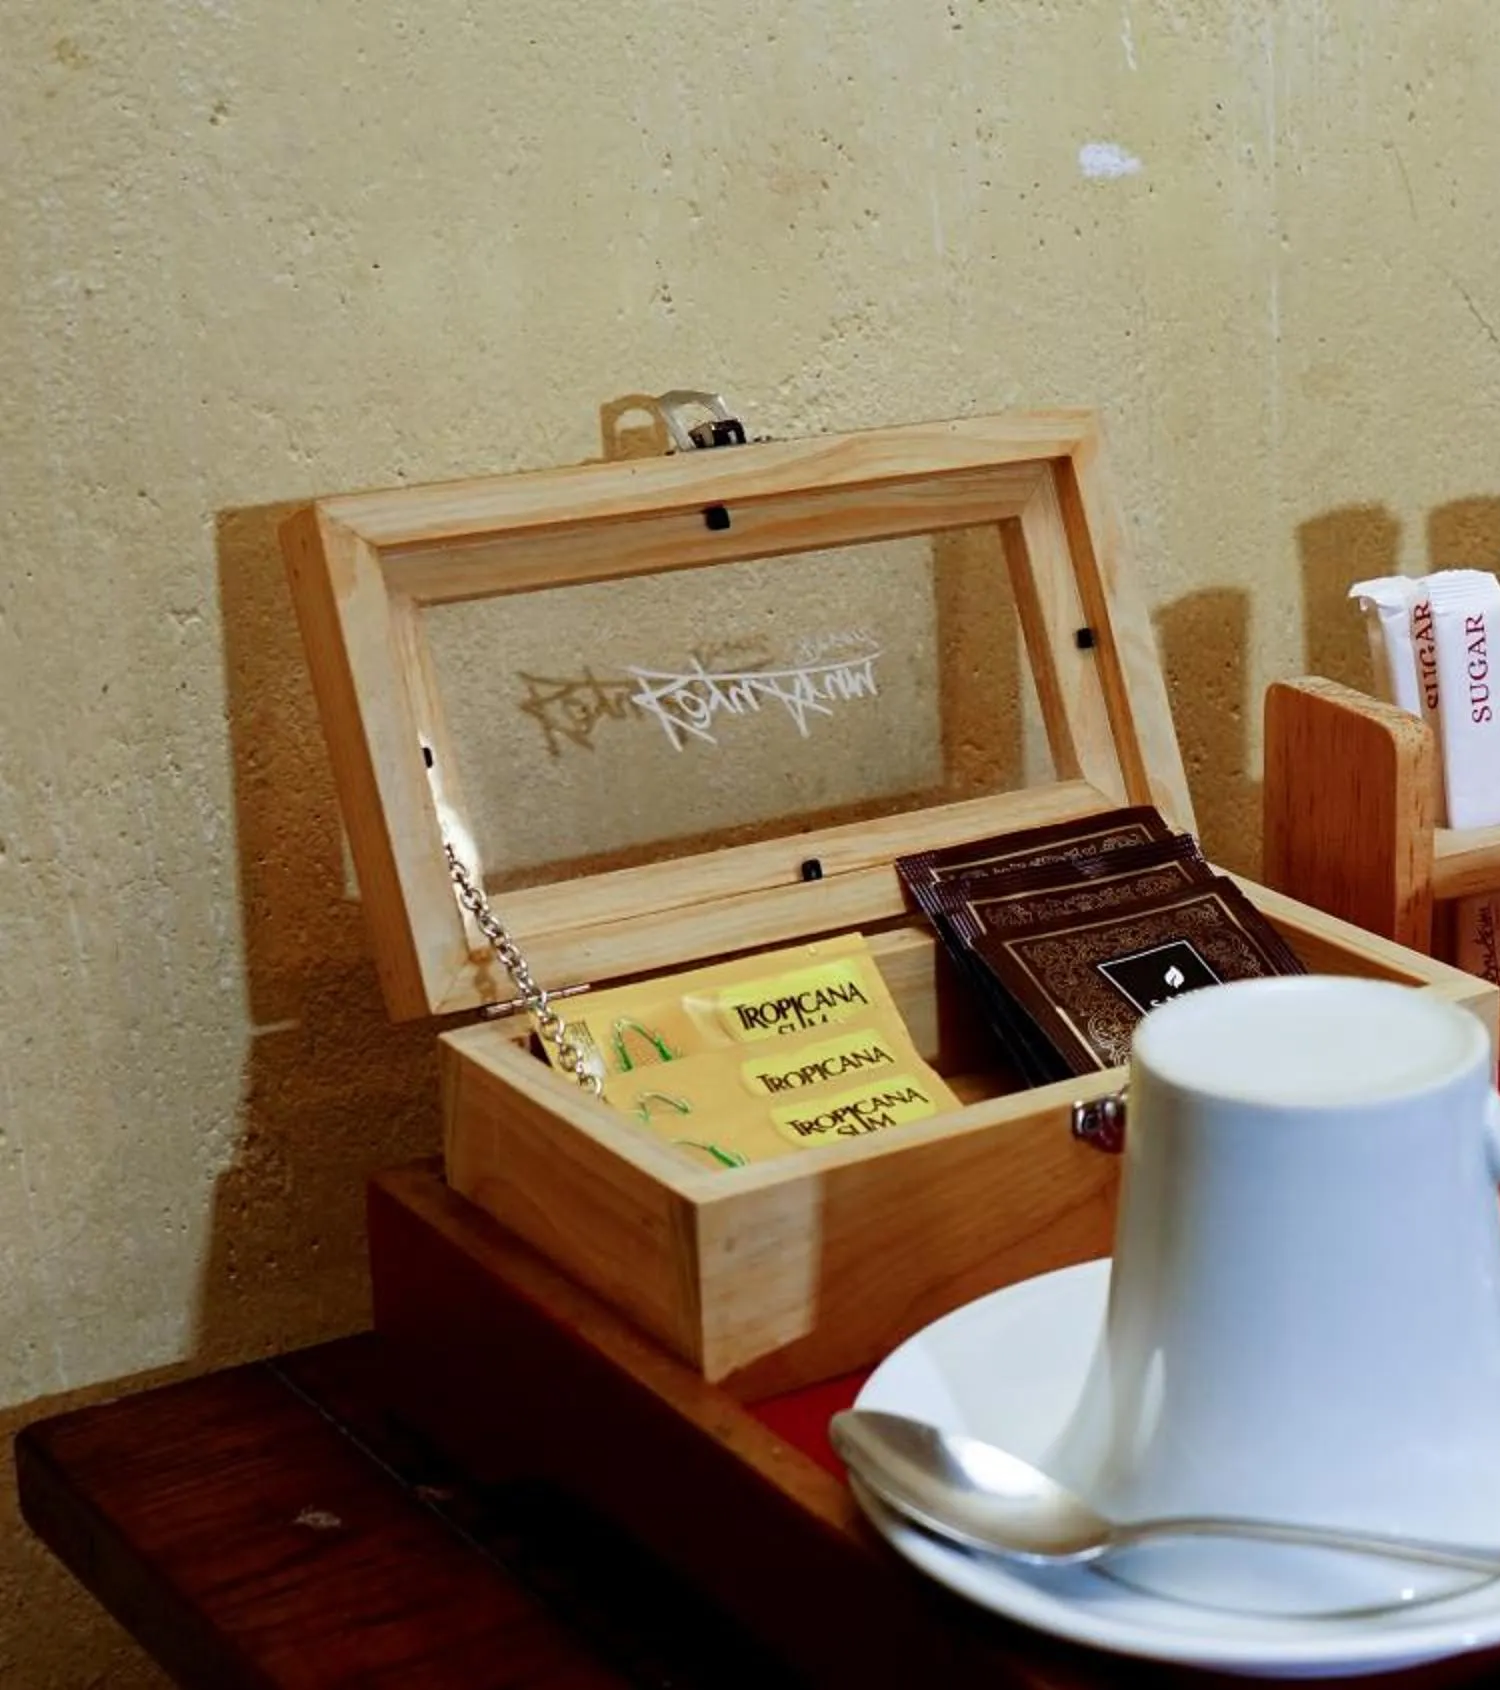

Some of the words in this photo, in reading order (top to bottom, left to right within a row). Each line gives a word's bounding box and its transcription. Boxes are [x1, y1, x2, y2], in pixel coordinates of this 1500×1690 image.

[1465, 613, 1493, 724] SUGAR
[732, 982, 869, 1031] TROPICANA
[756, 1046, 895, 1094] TROPICANA
[784, 1087, 930, 1137] TROPICANA
